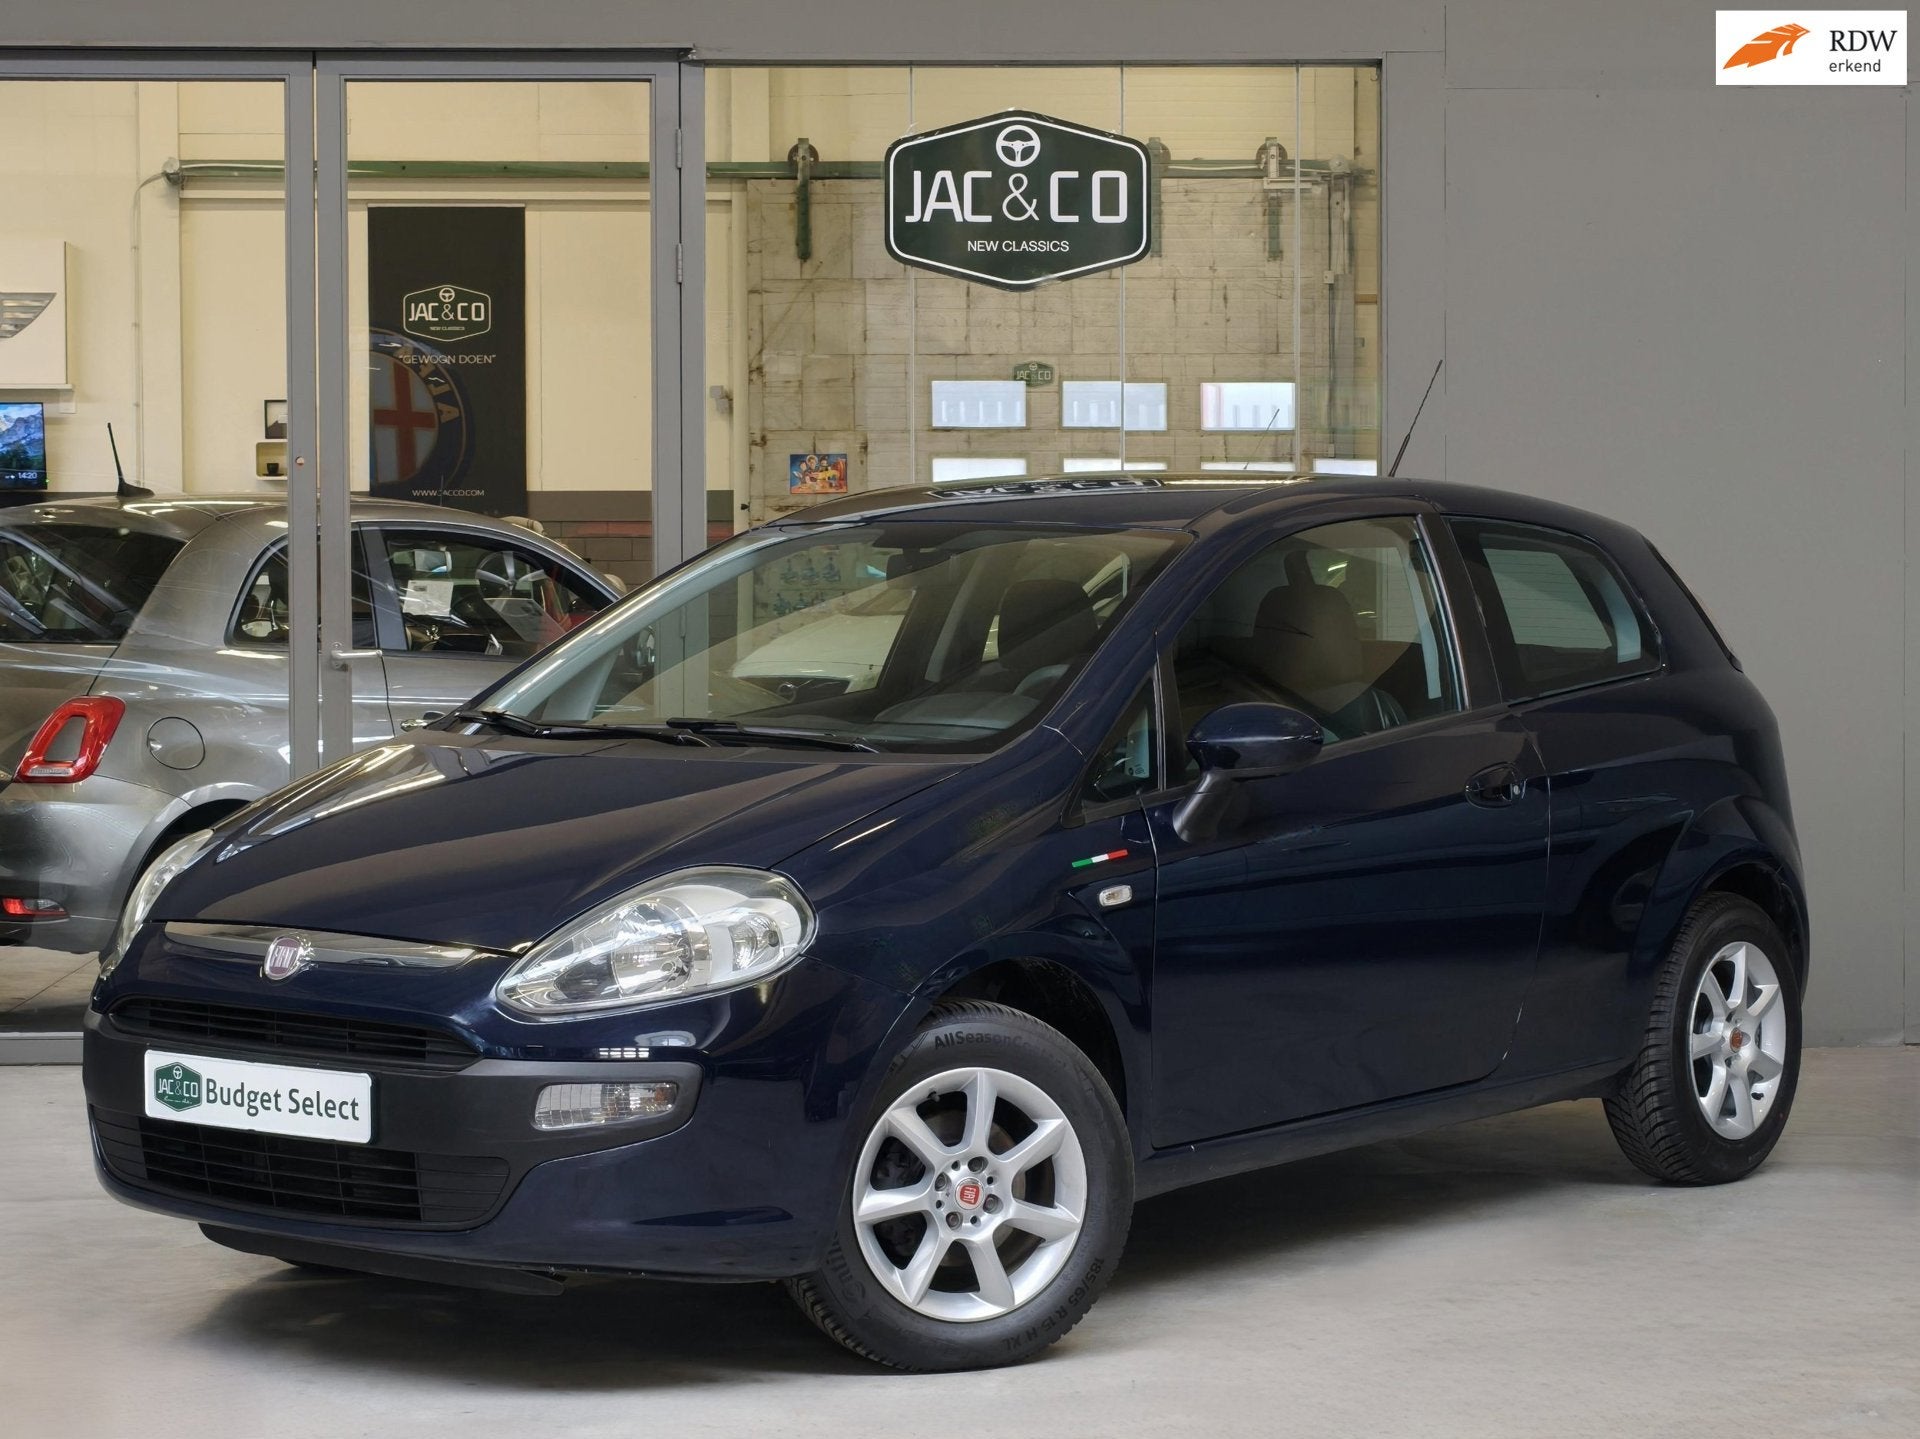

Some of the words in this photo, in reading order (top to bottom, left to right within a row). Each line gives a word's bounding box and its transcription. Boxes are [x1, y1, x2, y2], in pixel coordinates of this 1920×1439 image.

[967, 240, 999, 252] NEW
[1002, 240, 1070, 252] CLASSICS
[206, 1078, 282, 1117] Budget
[288, 1088, 360, 1121] Select
